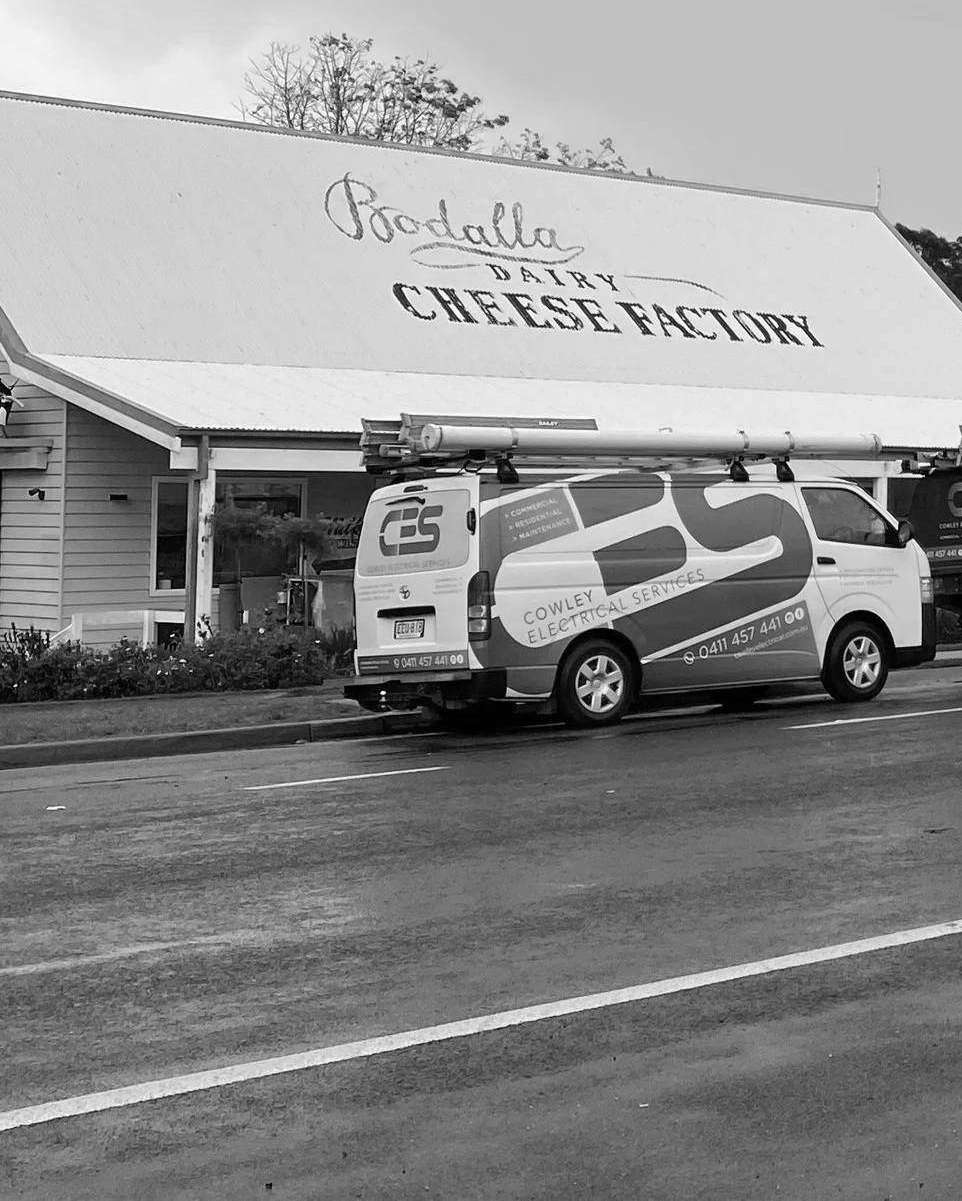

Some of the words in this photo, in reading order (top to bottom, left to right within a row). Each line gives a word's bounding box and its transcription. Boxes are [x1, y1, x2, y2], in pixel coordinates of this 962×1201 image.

[325, 171, 584, 250] Bodalla
[486, 263, 619, 292] DAIRY
[393, 283, 622, 334] CHEESE
[615, 301, 825, 348] FACTORY
[510, 498, 558, 517] COMMERCIAL
[515, 509, 562, 529] RESIDENTIAL
[519, 518, 571, 539] MAINTENANCE
[939, 522, 959, 530] COWLEY
[935, 549, 946, 557] 457
[523, 589, 592, 625] COWLEY
[527, 598, 628, 644] ELECTRICAL
[632, 568, 705, 605] SERVICES
[699, 637, 728, 659] 0411
[731, 626, 755, 646] 457
[760, 616, 781, 634] 441
[401, 658, 417, 668] 0411
[419, 656, 432, 667] 457
[434, 656, 448, 666] 441
